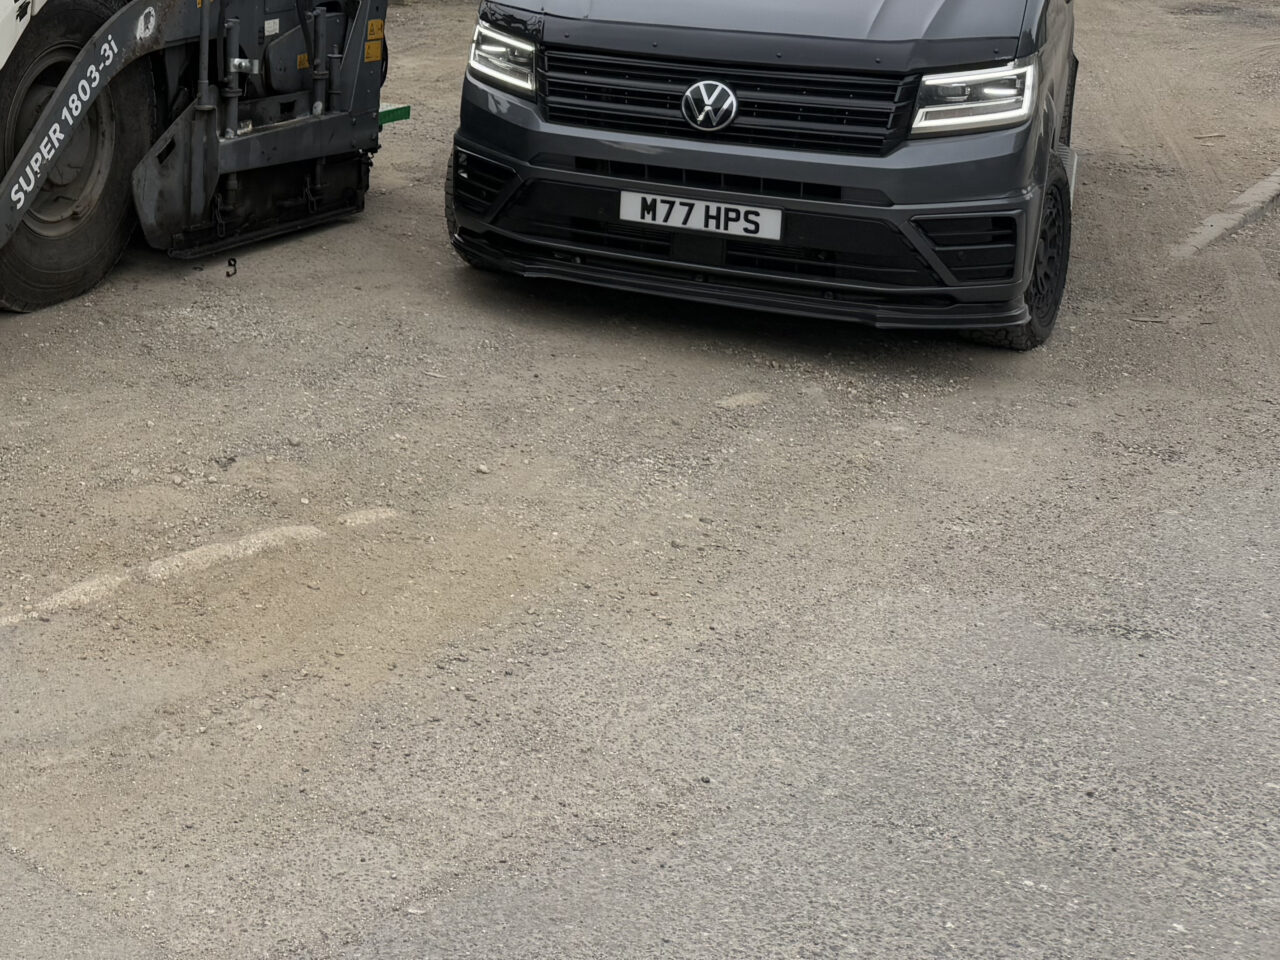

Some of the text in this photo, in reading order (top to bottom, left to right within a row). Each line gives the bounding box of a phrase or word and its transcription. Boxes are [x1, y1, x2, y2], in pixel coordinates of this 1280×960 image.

[10, 34, 119, 210] SUPER 1803-3i
[640, 196, 761, 235] M77 HPS
